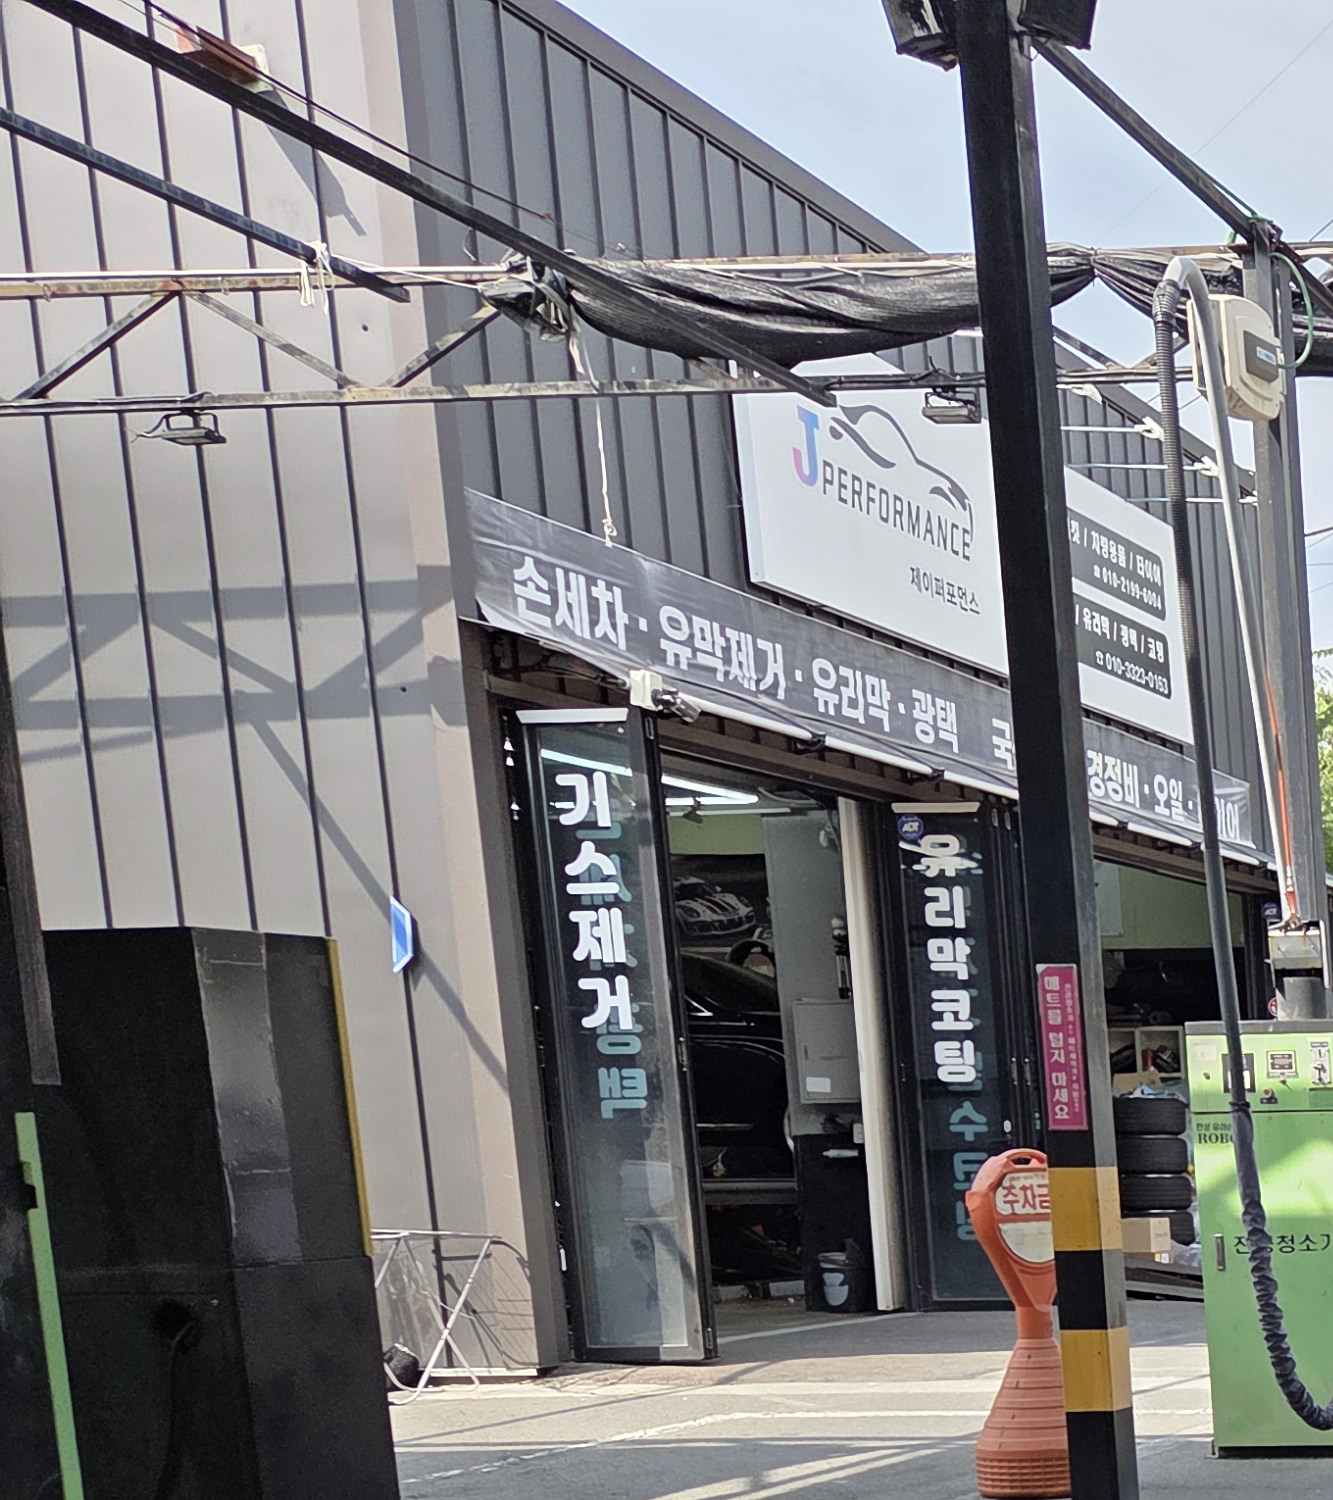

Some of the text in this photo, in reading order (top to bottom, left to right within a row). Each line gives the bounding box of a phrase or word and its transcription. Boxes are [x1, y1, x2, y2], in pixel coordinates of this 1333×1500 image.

[823, 459, 971, 561] PERFORMANCE
[910, 566, 981, 615] 제이퍼포먼스
[1136, 554, 1162, 587] 타이어
[513, 556, 629, 651] 손세차
[659, 605, 786, 700] 유막제거
[812, 658, 891, 732] 유리막
[912, 689, 959, 753] 광택
[1087, 750, 1140, 809] 경정비
[1154, 774, 1185, 822] 오일
[920, 834, 977, 1084] 유리막코팅
[1002, 1184, 1051, 1215] 주차금
